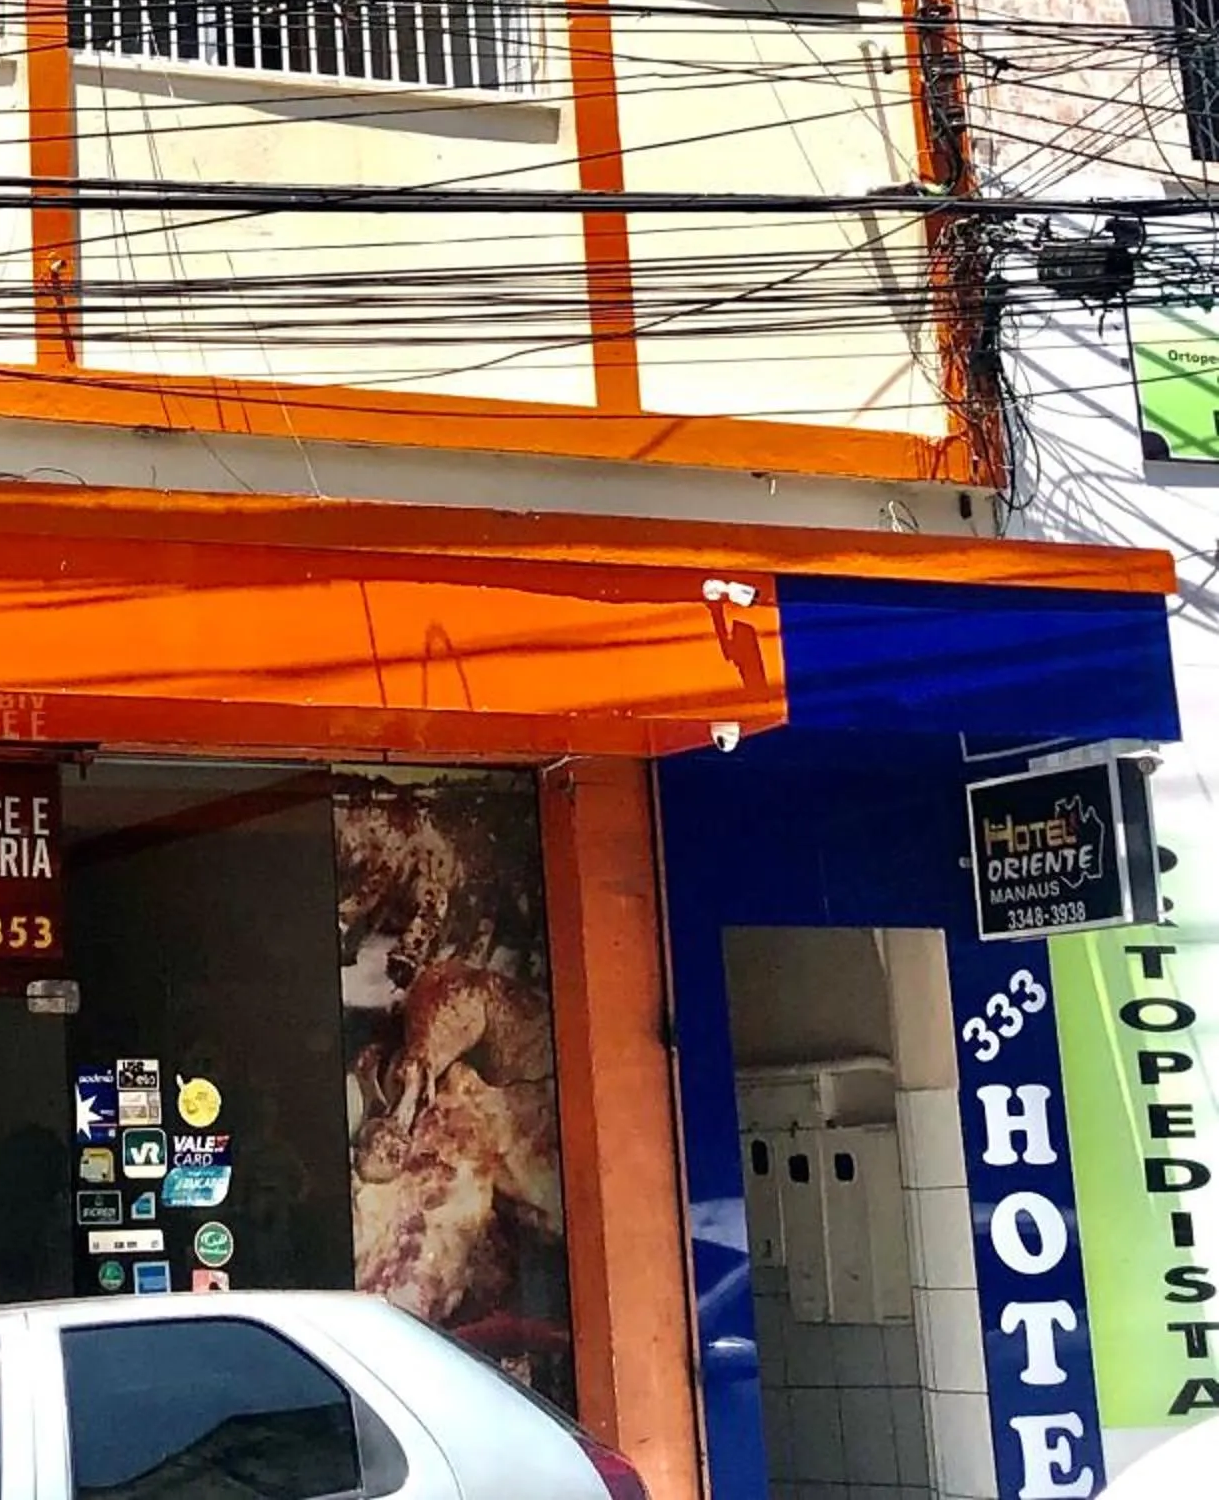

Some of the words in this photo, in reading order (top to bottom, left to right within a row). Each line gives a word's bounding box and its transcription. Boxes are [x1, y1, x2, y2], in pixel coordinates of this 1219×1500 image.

[1167, 349, 1219, 366] Ortope
[33, 797, 50, 836] E
[984, 812, 1080, 856] HOTEL
[987, 844, 1094, 883] ORIENTE
[989, 880, 1061, 905] MANAUS
[1007, 901, 1086, 930] 3348-3938
[963, 969, 1047, 1062] 333
[173, 1136, 217, 1153] VALE
[1120, 845, 1219, 1416] TOPEDISTA
[173, 1154, 213, 1166] CARD
